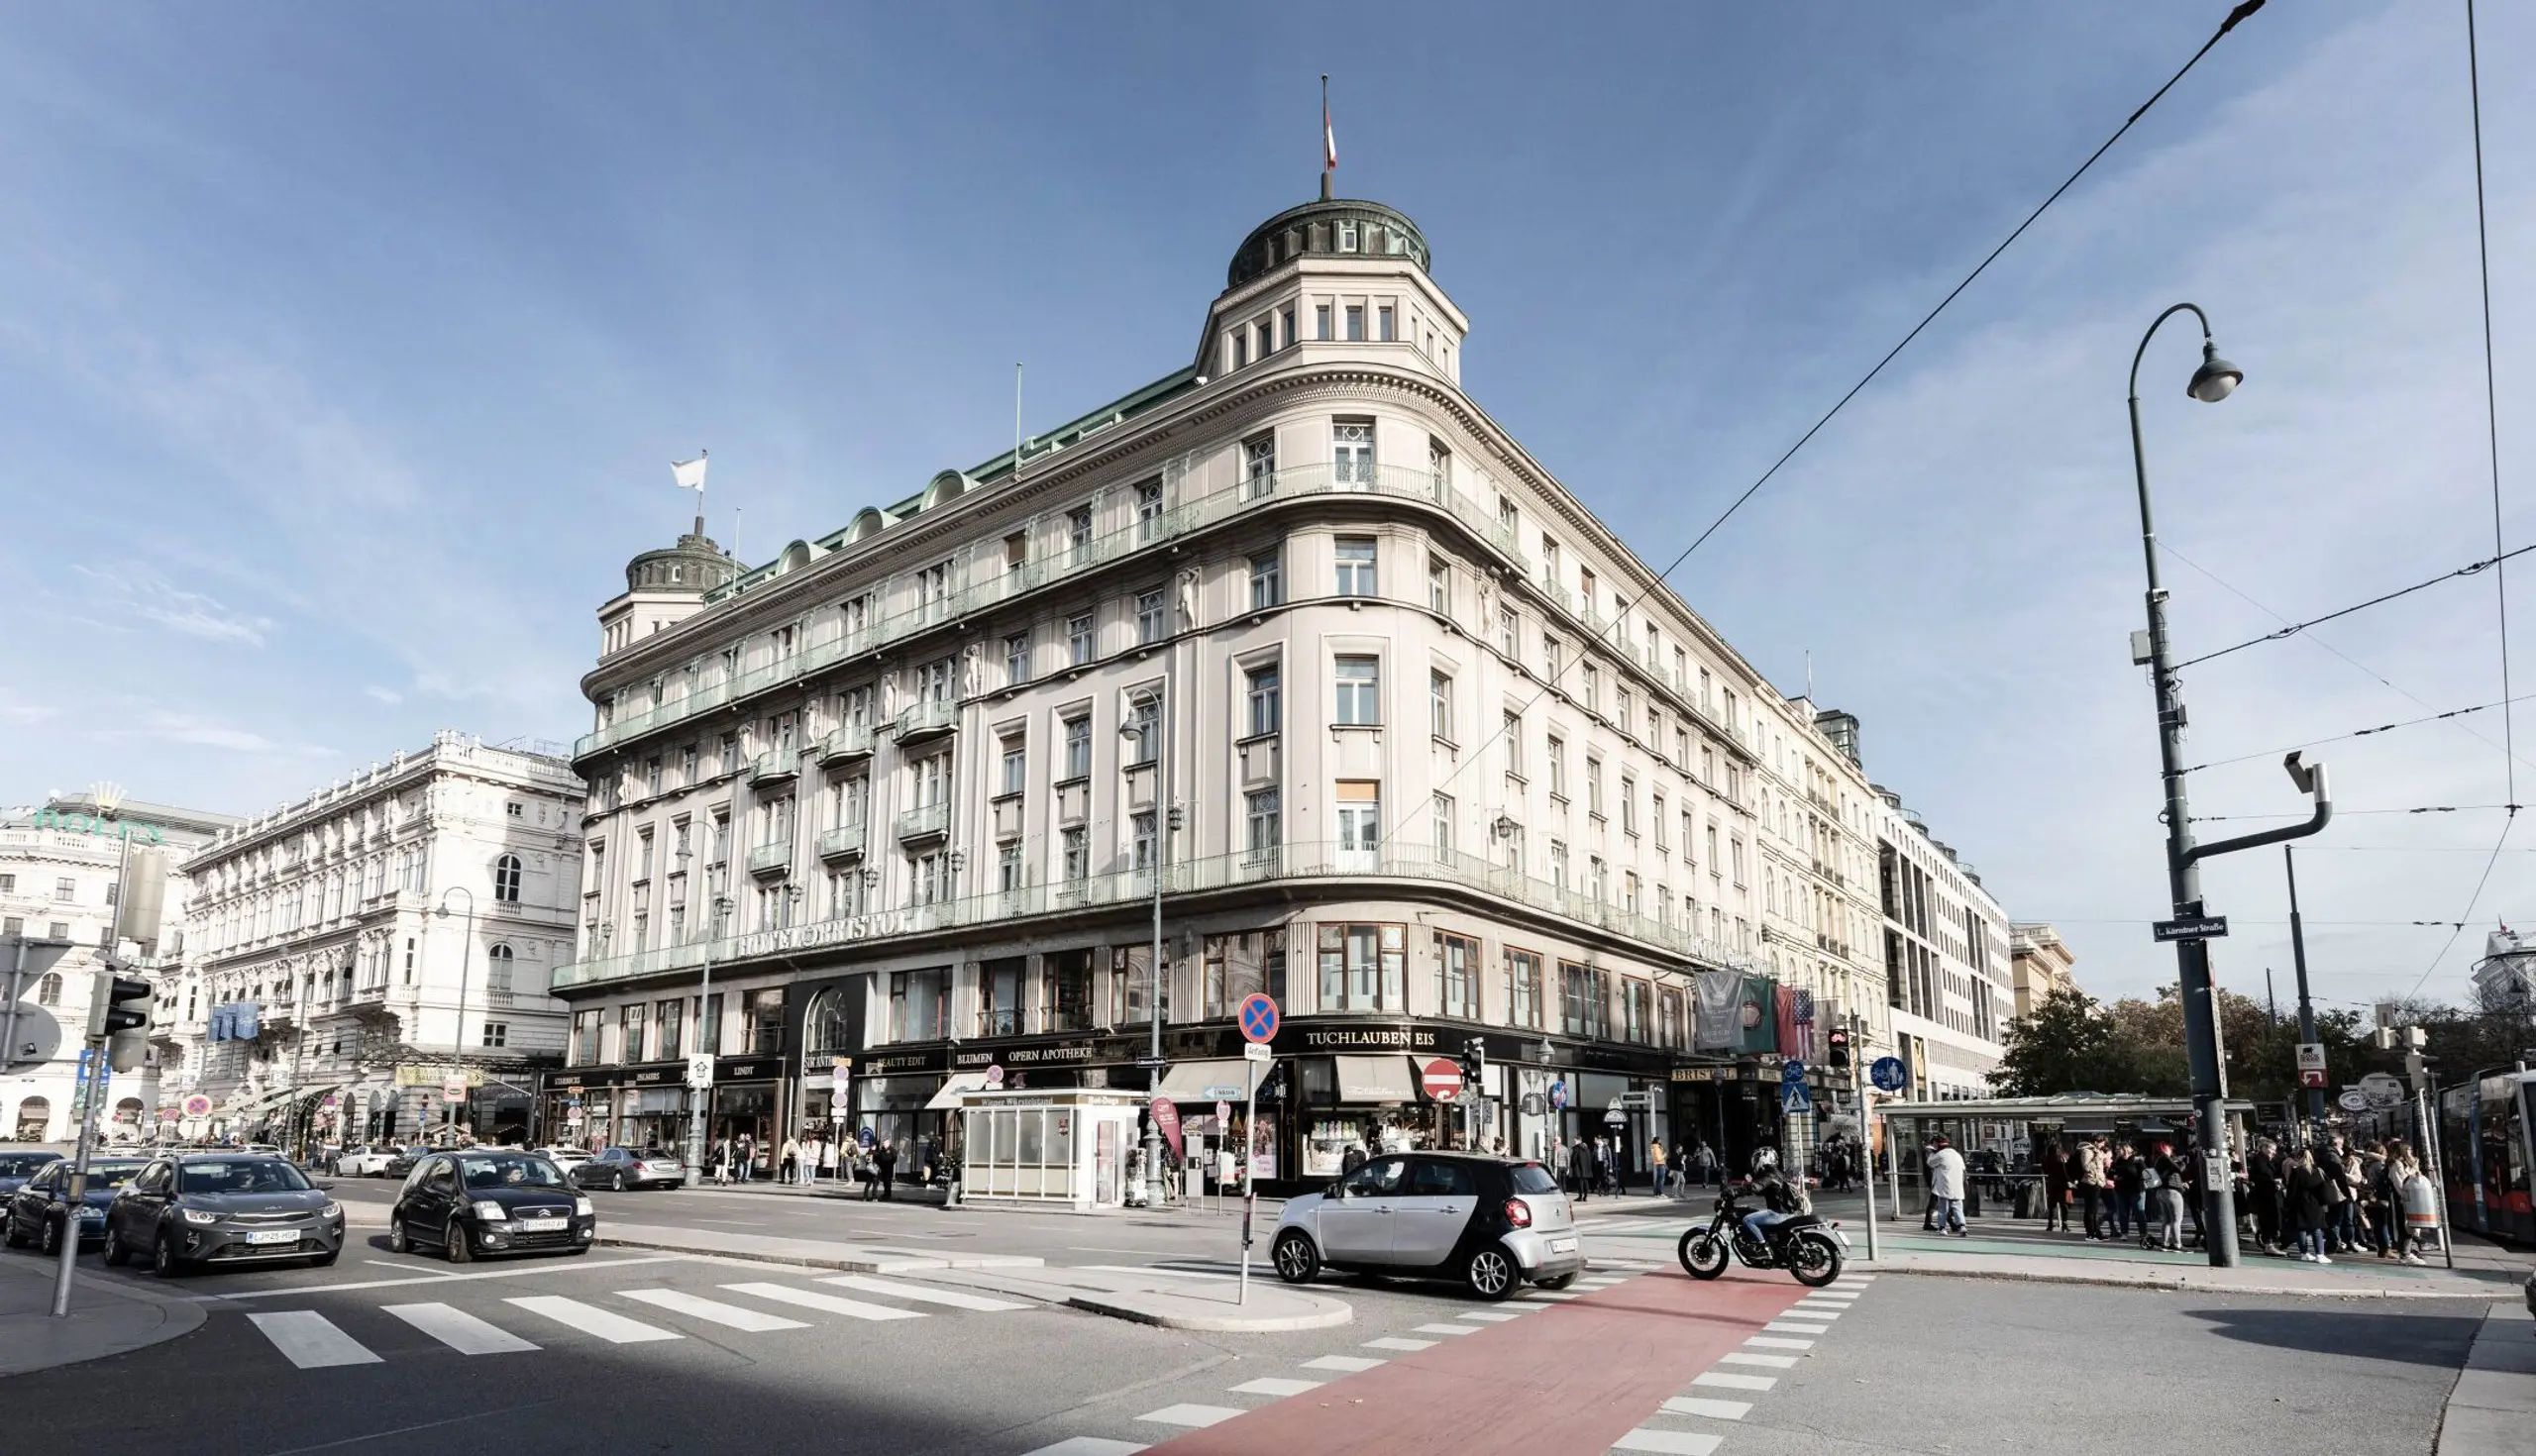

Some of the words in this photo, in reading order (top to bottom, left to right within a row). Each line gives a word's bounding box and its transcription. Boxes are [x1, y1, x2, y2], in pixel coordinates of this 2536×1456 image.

[820, 909, 911, 941] BRISTOL
[2199, 922, 2224, 932] Straße
[1307, 1031, 1412, 1045] TUCHLAUBEN
[1415, 1033, 1434, 1045] EIS
[957, 1053, 993, 1064] BLUMEN
[1008, 1050, 1039, 1062] OPERN
[1042, 1047, 1093, 1060] APOTHEKE
[877, 1057, 905, 1068] BEAUTY
[907, 1056, 926, 1066] EDIT
[734, 1067, 754, 1076] LINDT
[1675, 1069, 1734, 1080] BRISTL
